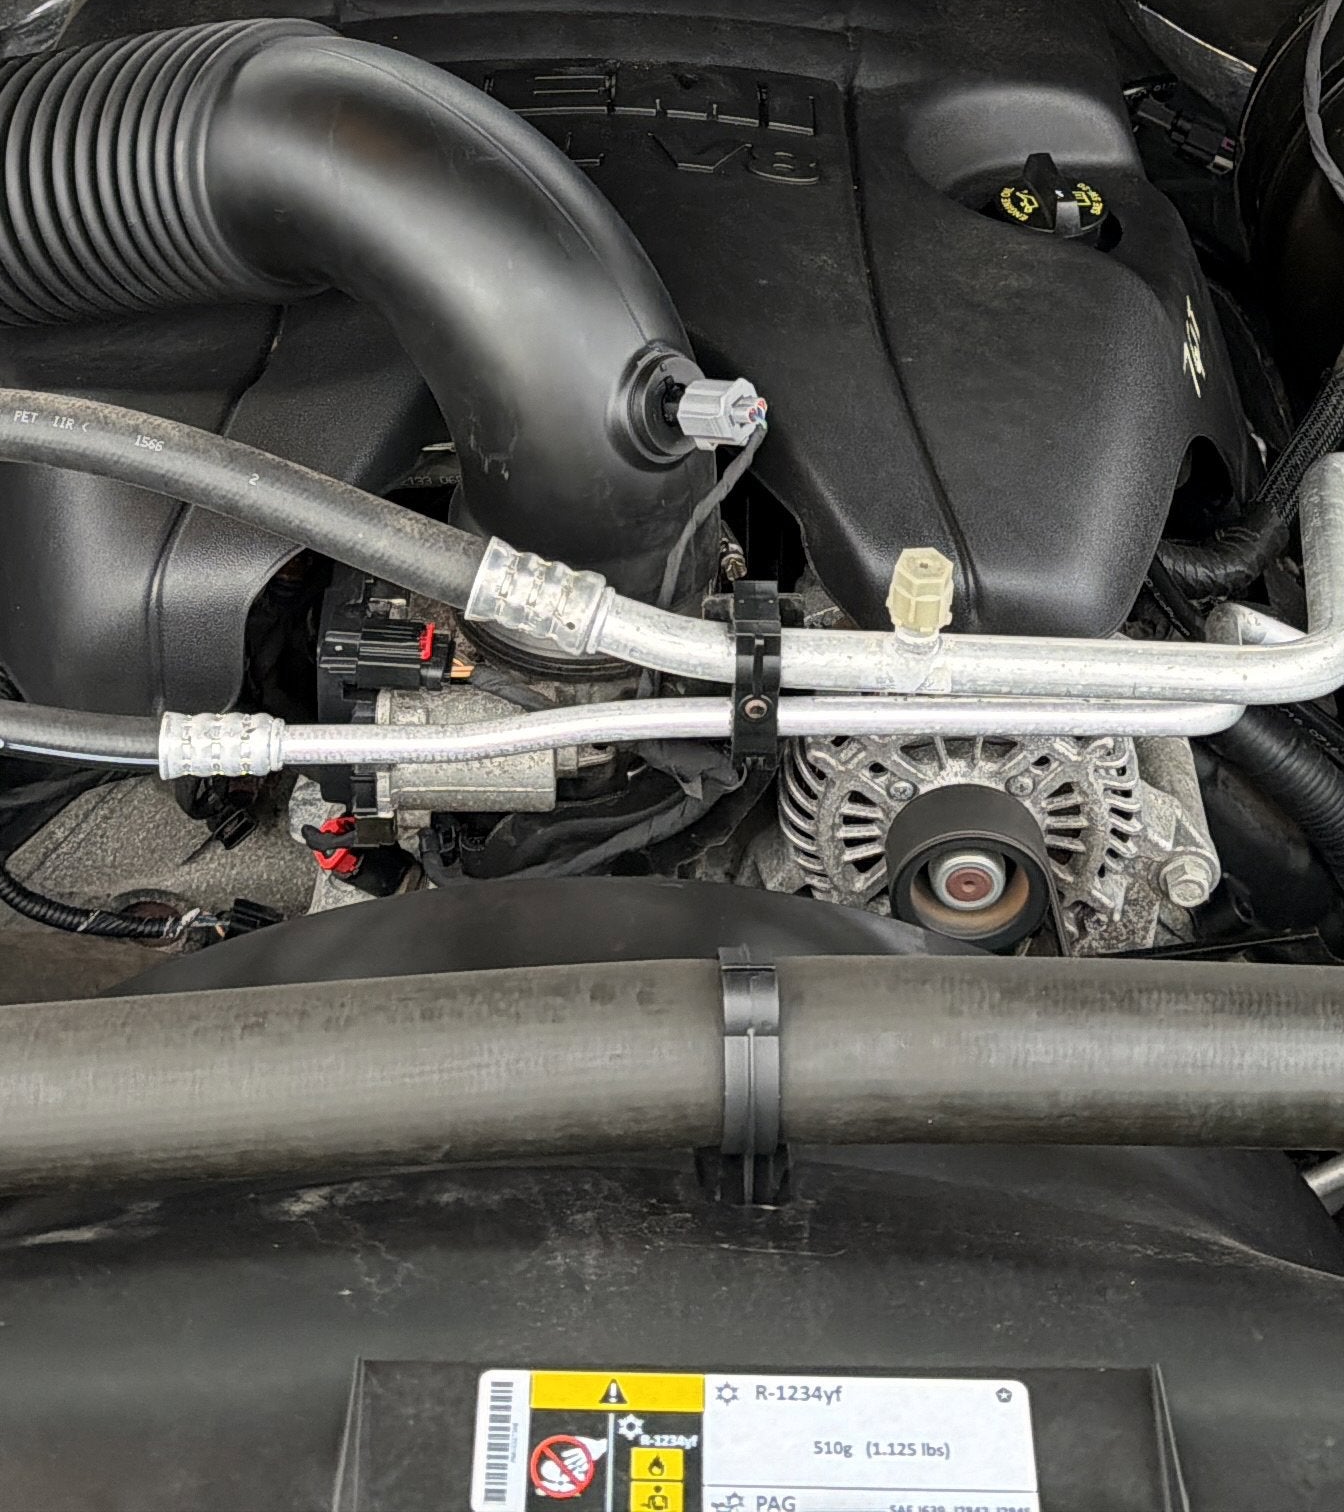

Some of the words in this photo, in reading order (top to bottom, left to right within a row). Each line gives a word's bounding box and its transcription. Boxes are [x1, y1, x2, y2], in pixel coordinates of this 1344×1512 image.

[13, 410, 39, 424] PET
[134, 434, 165, 452] 1566
[755, 1384, 843, 1406] R-1234yf
[640, 1434, 698, 1450] R-1234yf
[813, 1441, 853, 1459] 510g
[865, 1441, 916, 1459] (1.125
[921, 1441, 951, 1460] lbs)
[756, 1495, 796, 1512] PAG
